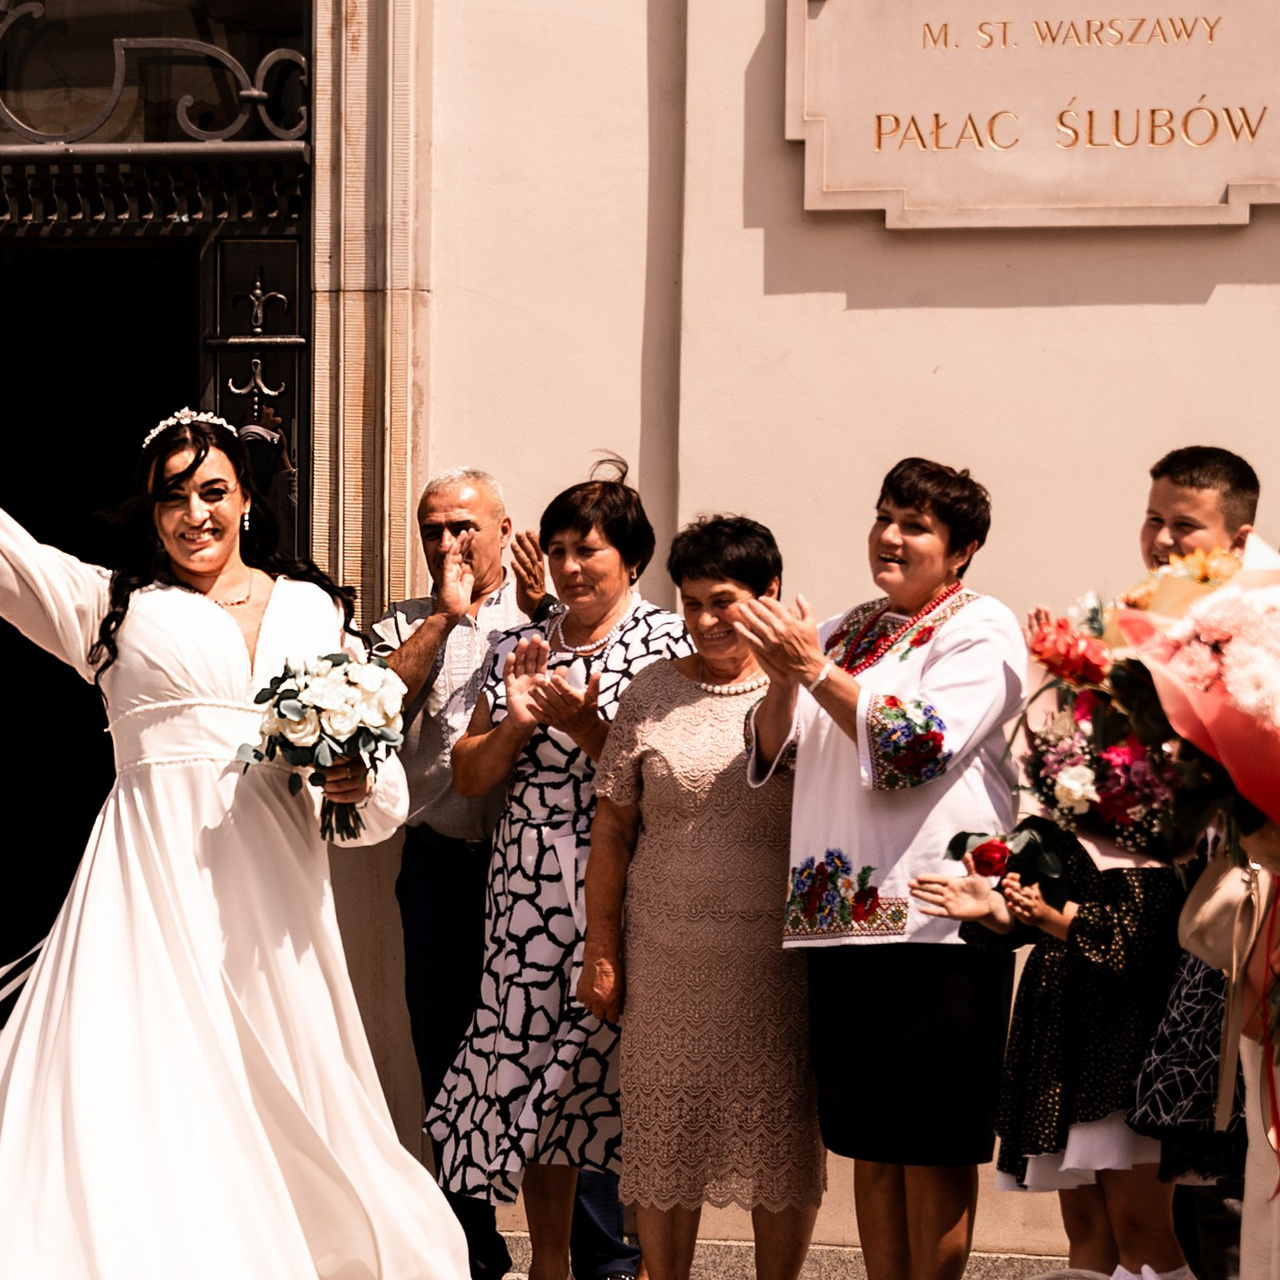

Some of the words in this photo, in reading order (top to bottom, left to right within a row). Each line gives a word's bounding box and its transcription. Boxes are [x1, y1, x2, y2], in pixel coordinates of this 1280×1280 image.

[922, 21, 959, 50] M.
[976, 20, 1019, 50] ST.
[1033, 17, 1222, 48] WARSZAWY
[873, 111, 1020, 153] PAŁAC
[1055, 94, 1269, 151] ŚLUBÓW
